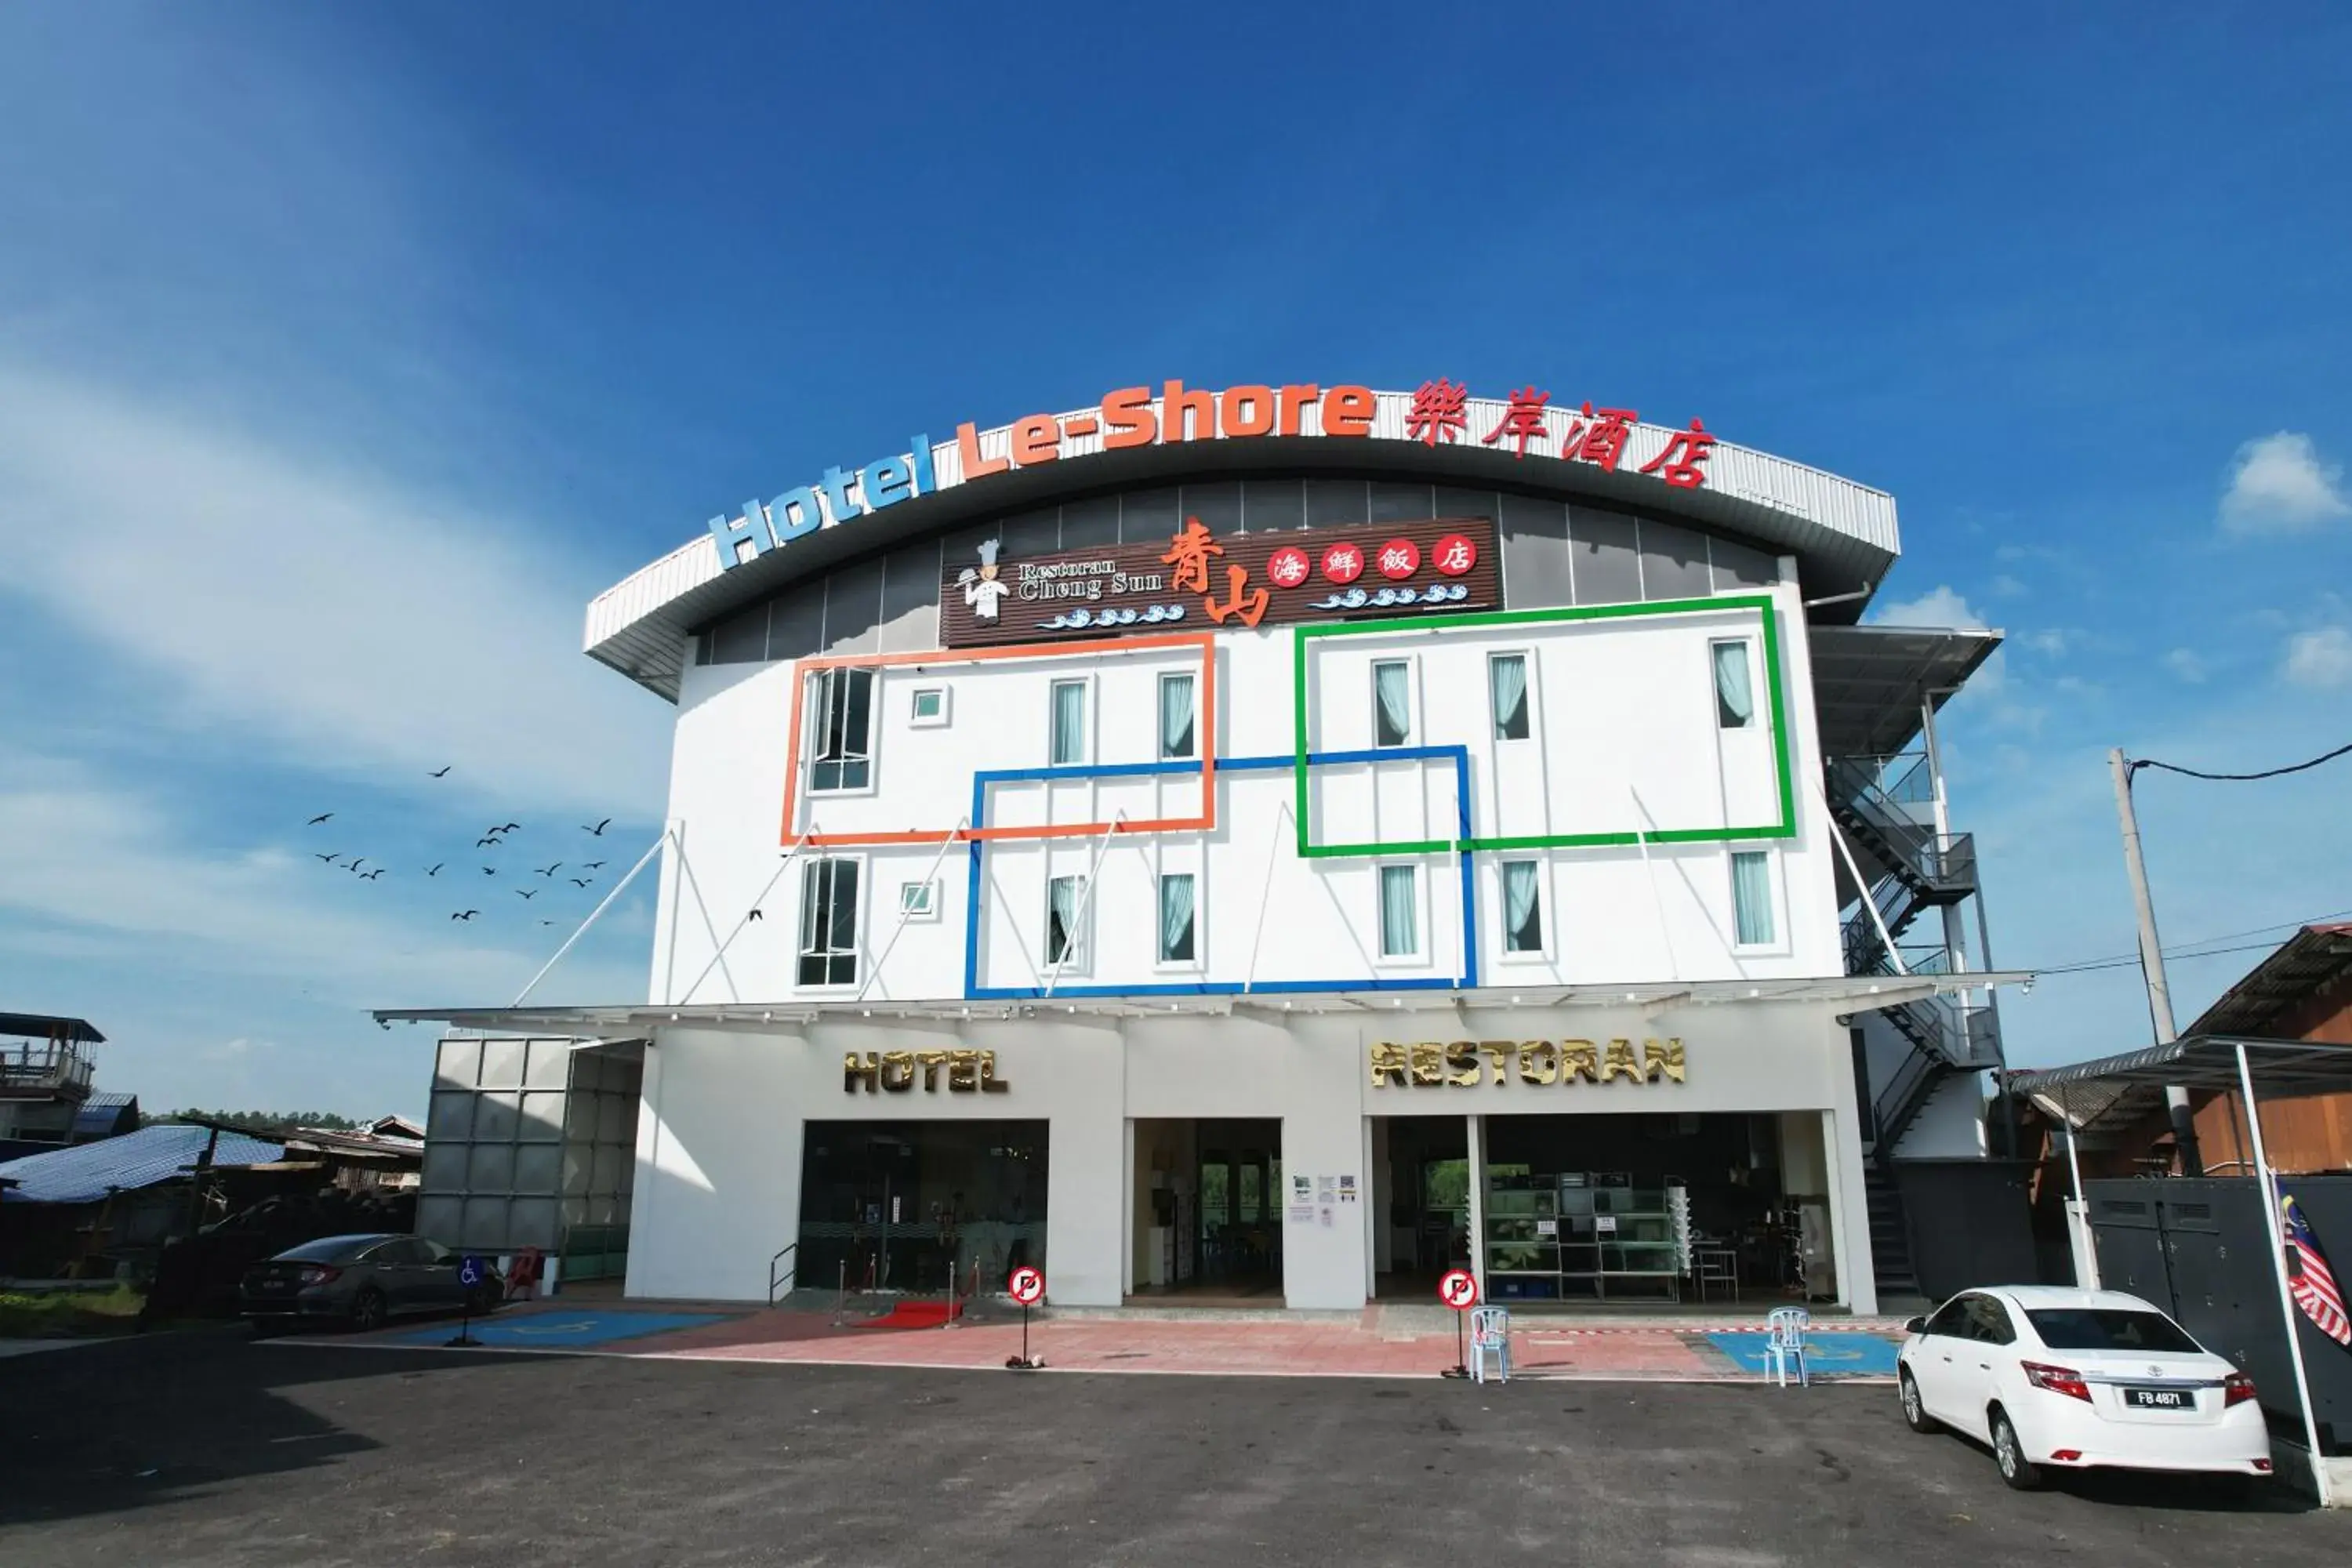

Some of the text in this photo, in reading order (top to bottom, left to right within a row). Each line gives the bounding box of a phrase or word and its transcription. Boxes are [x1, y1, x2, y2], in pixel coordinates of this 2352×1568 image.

[1405, 376, 1717, 490] 樂岸酒店
[709, 379, 1375, 572] Hotel Le-Shore
[1018, 560, 1116, 581] Restoran
[1112, 572, 1162, 593] Sun
[1160, 515, 1471, 627] 青山 海鮮飯店
[843, 1048, 1009, 1094] HOTEL
[1370, 1036, 1686, 1087] RESTORAN
[2138, 1392, 2154, 1404] FB
